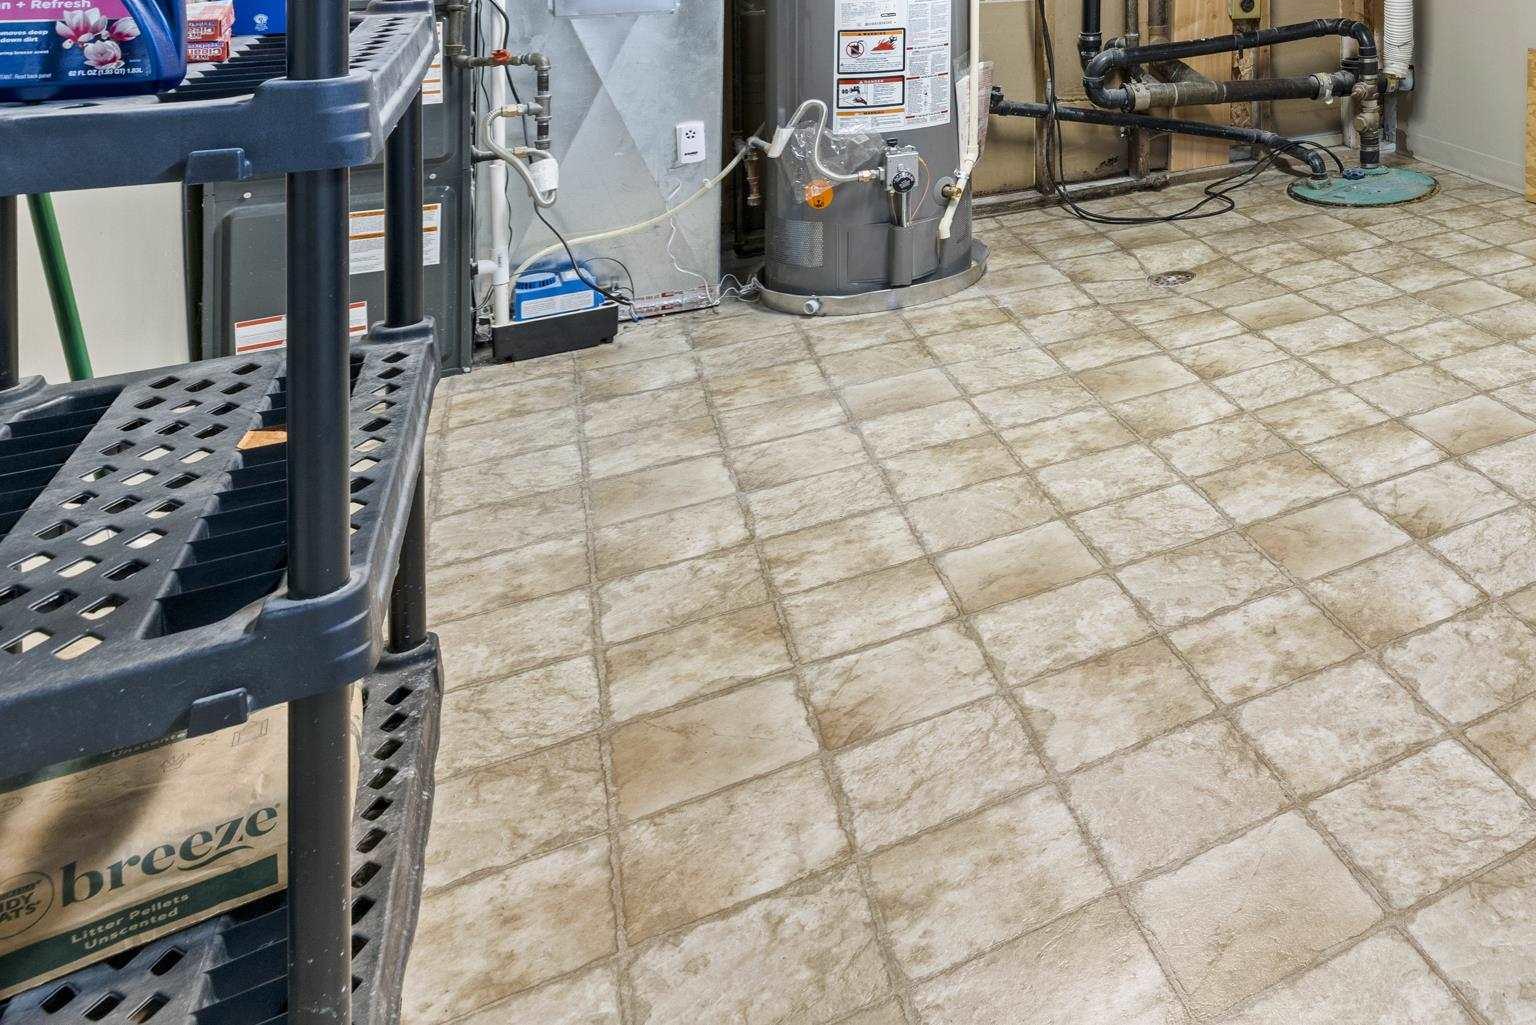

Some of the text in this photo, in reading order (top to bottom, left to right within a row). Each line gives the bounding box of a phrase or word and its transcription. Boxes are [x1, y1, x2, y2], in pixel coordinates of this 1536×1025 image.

[60, 804, 278, 908] breeze
[0, 905, 37, 923] ATS
[71, 893, 189, 944] Litter Pellets
[84, 907, 180, 950] Unscented
